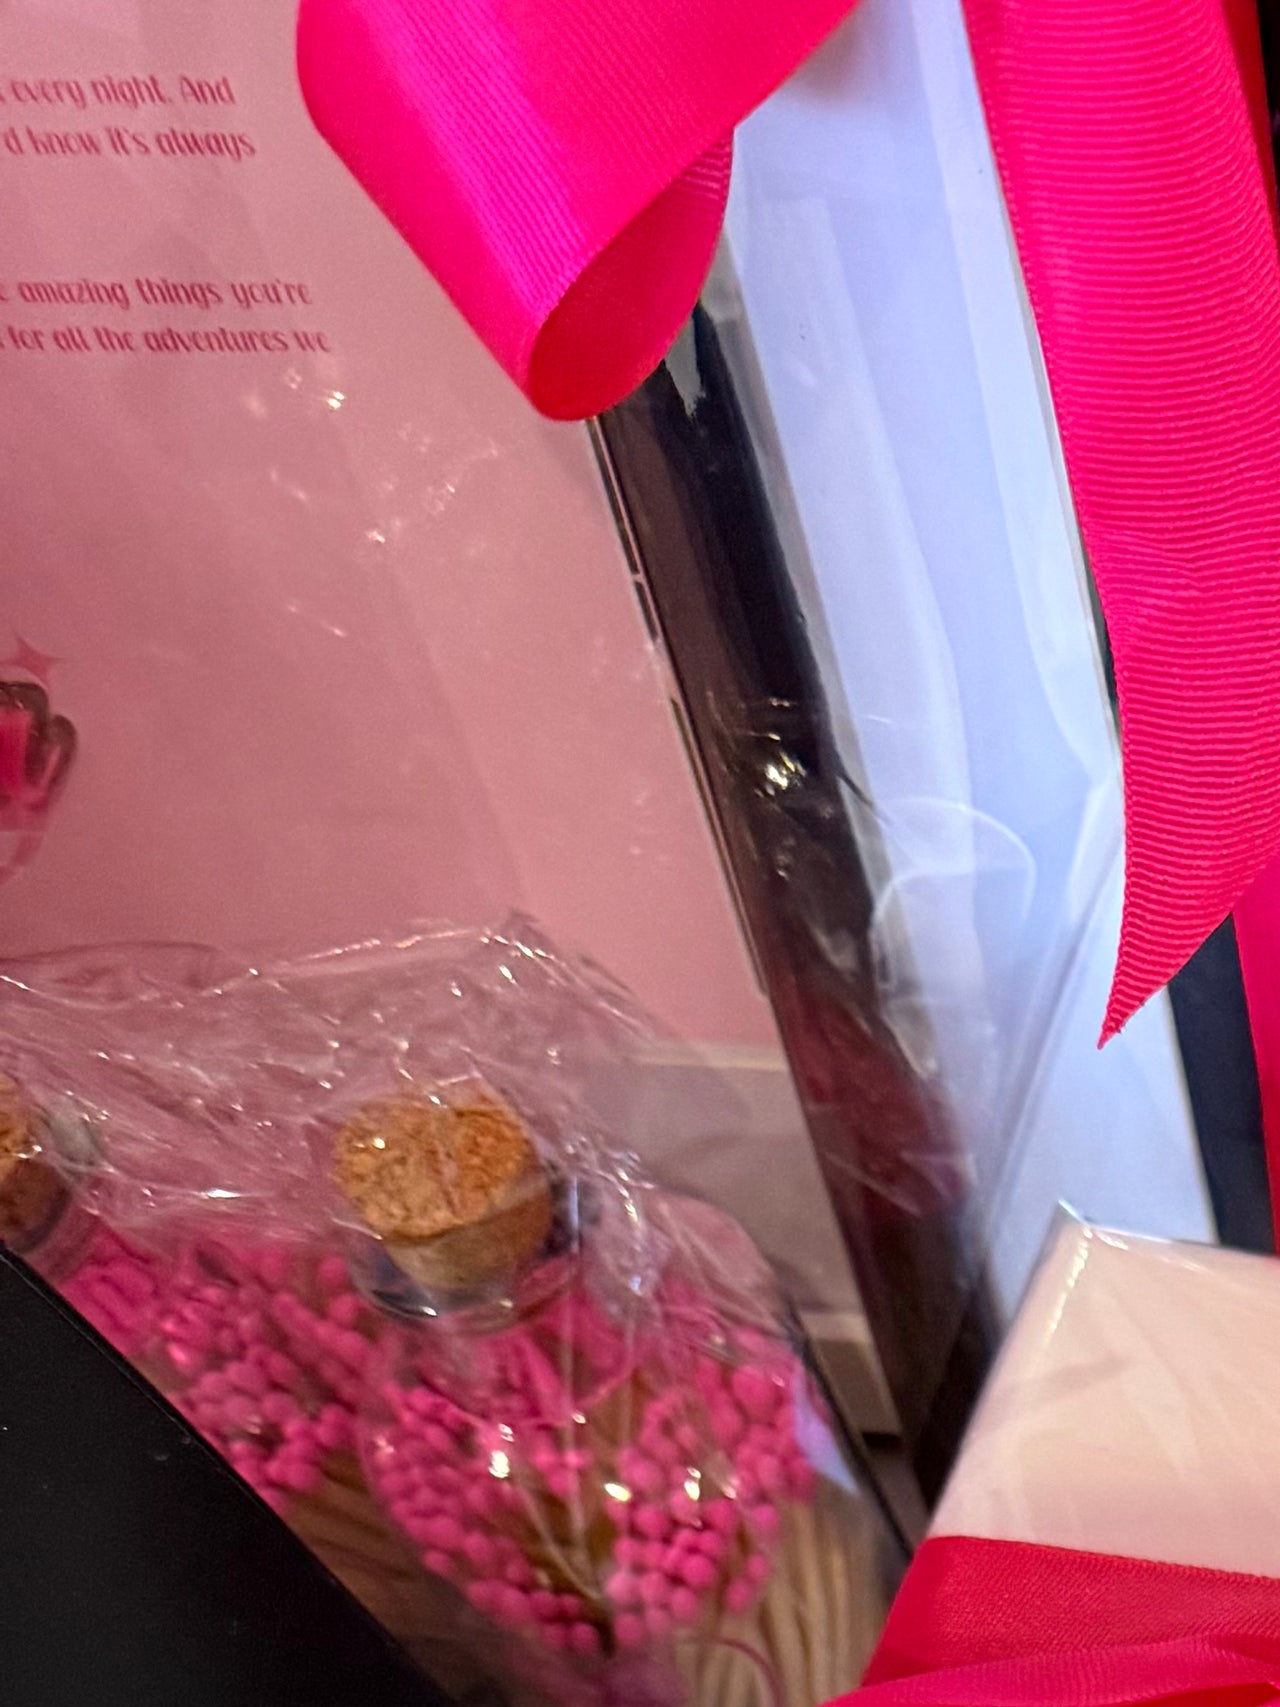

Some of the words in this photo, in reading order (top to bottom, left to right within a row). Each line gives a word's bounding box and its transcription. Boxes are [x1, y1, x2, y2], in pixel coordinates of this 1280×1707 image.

[10, 80, 87, 110] every
[180, 75, 236, 104] And
[26, 126, 101, 155] know
[155, 127, 256, 162] always
[18, 279, 130, 310] amazing
[135, 278, 223, 310] things
[230, 279, 312, 309] you're
[7, 325, 45, 351] for
[52, 326, 91, 352] all
[93, 326, 135, 352] the
[143, 326, 289, 353] adventures
[292, 330, 331, 353] we
